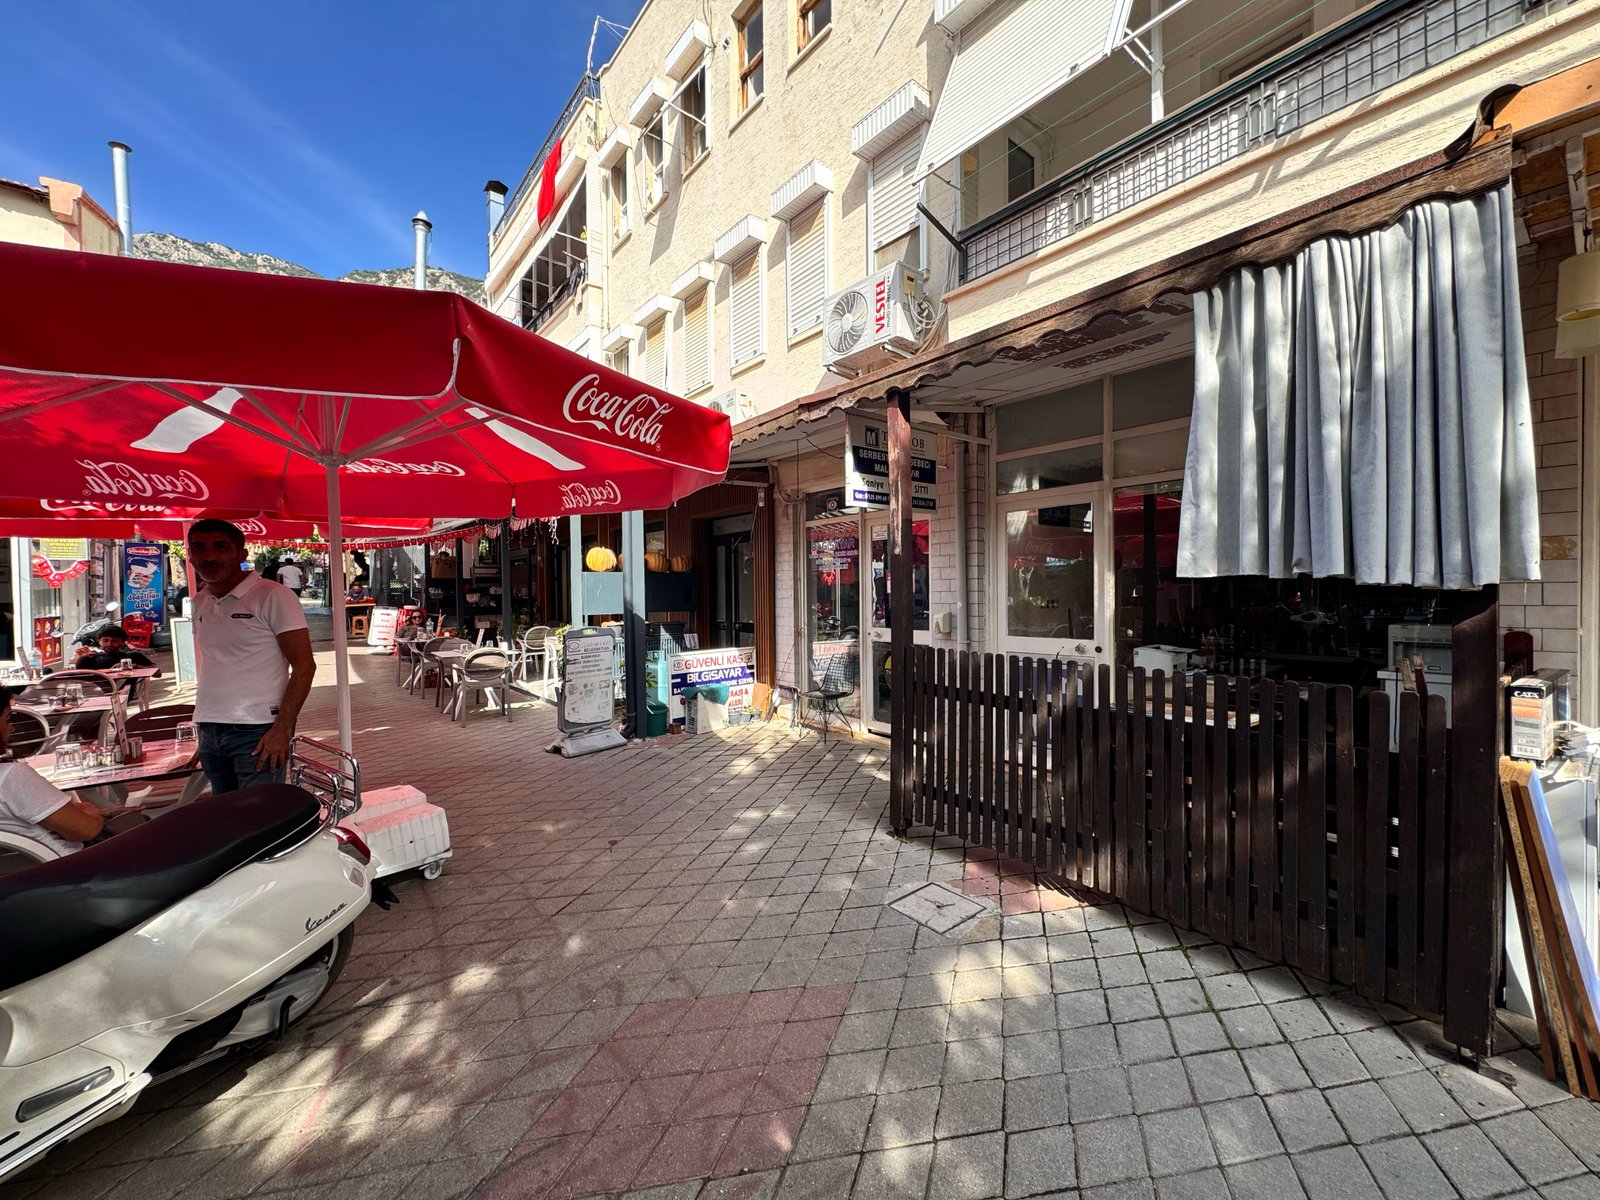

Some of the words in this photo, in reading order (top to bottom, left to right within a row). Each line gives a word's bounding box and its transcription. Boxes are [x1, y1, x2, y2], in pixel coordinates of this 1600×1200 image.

[875, 276, 886, 334] VESTEL
[562, 373, 675, 446] Coca-Cola
[874, 463, 889, 474] MAL
[861, 477, 885, 491] Saniye
[684, 655, 725, 669] GÜVENLİ
[1513, 690, 1540, 699] CATA
[304, 902, 348, 937] Vespa
